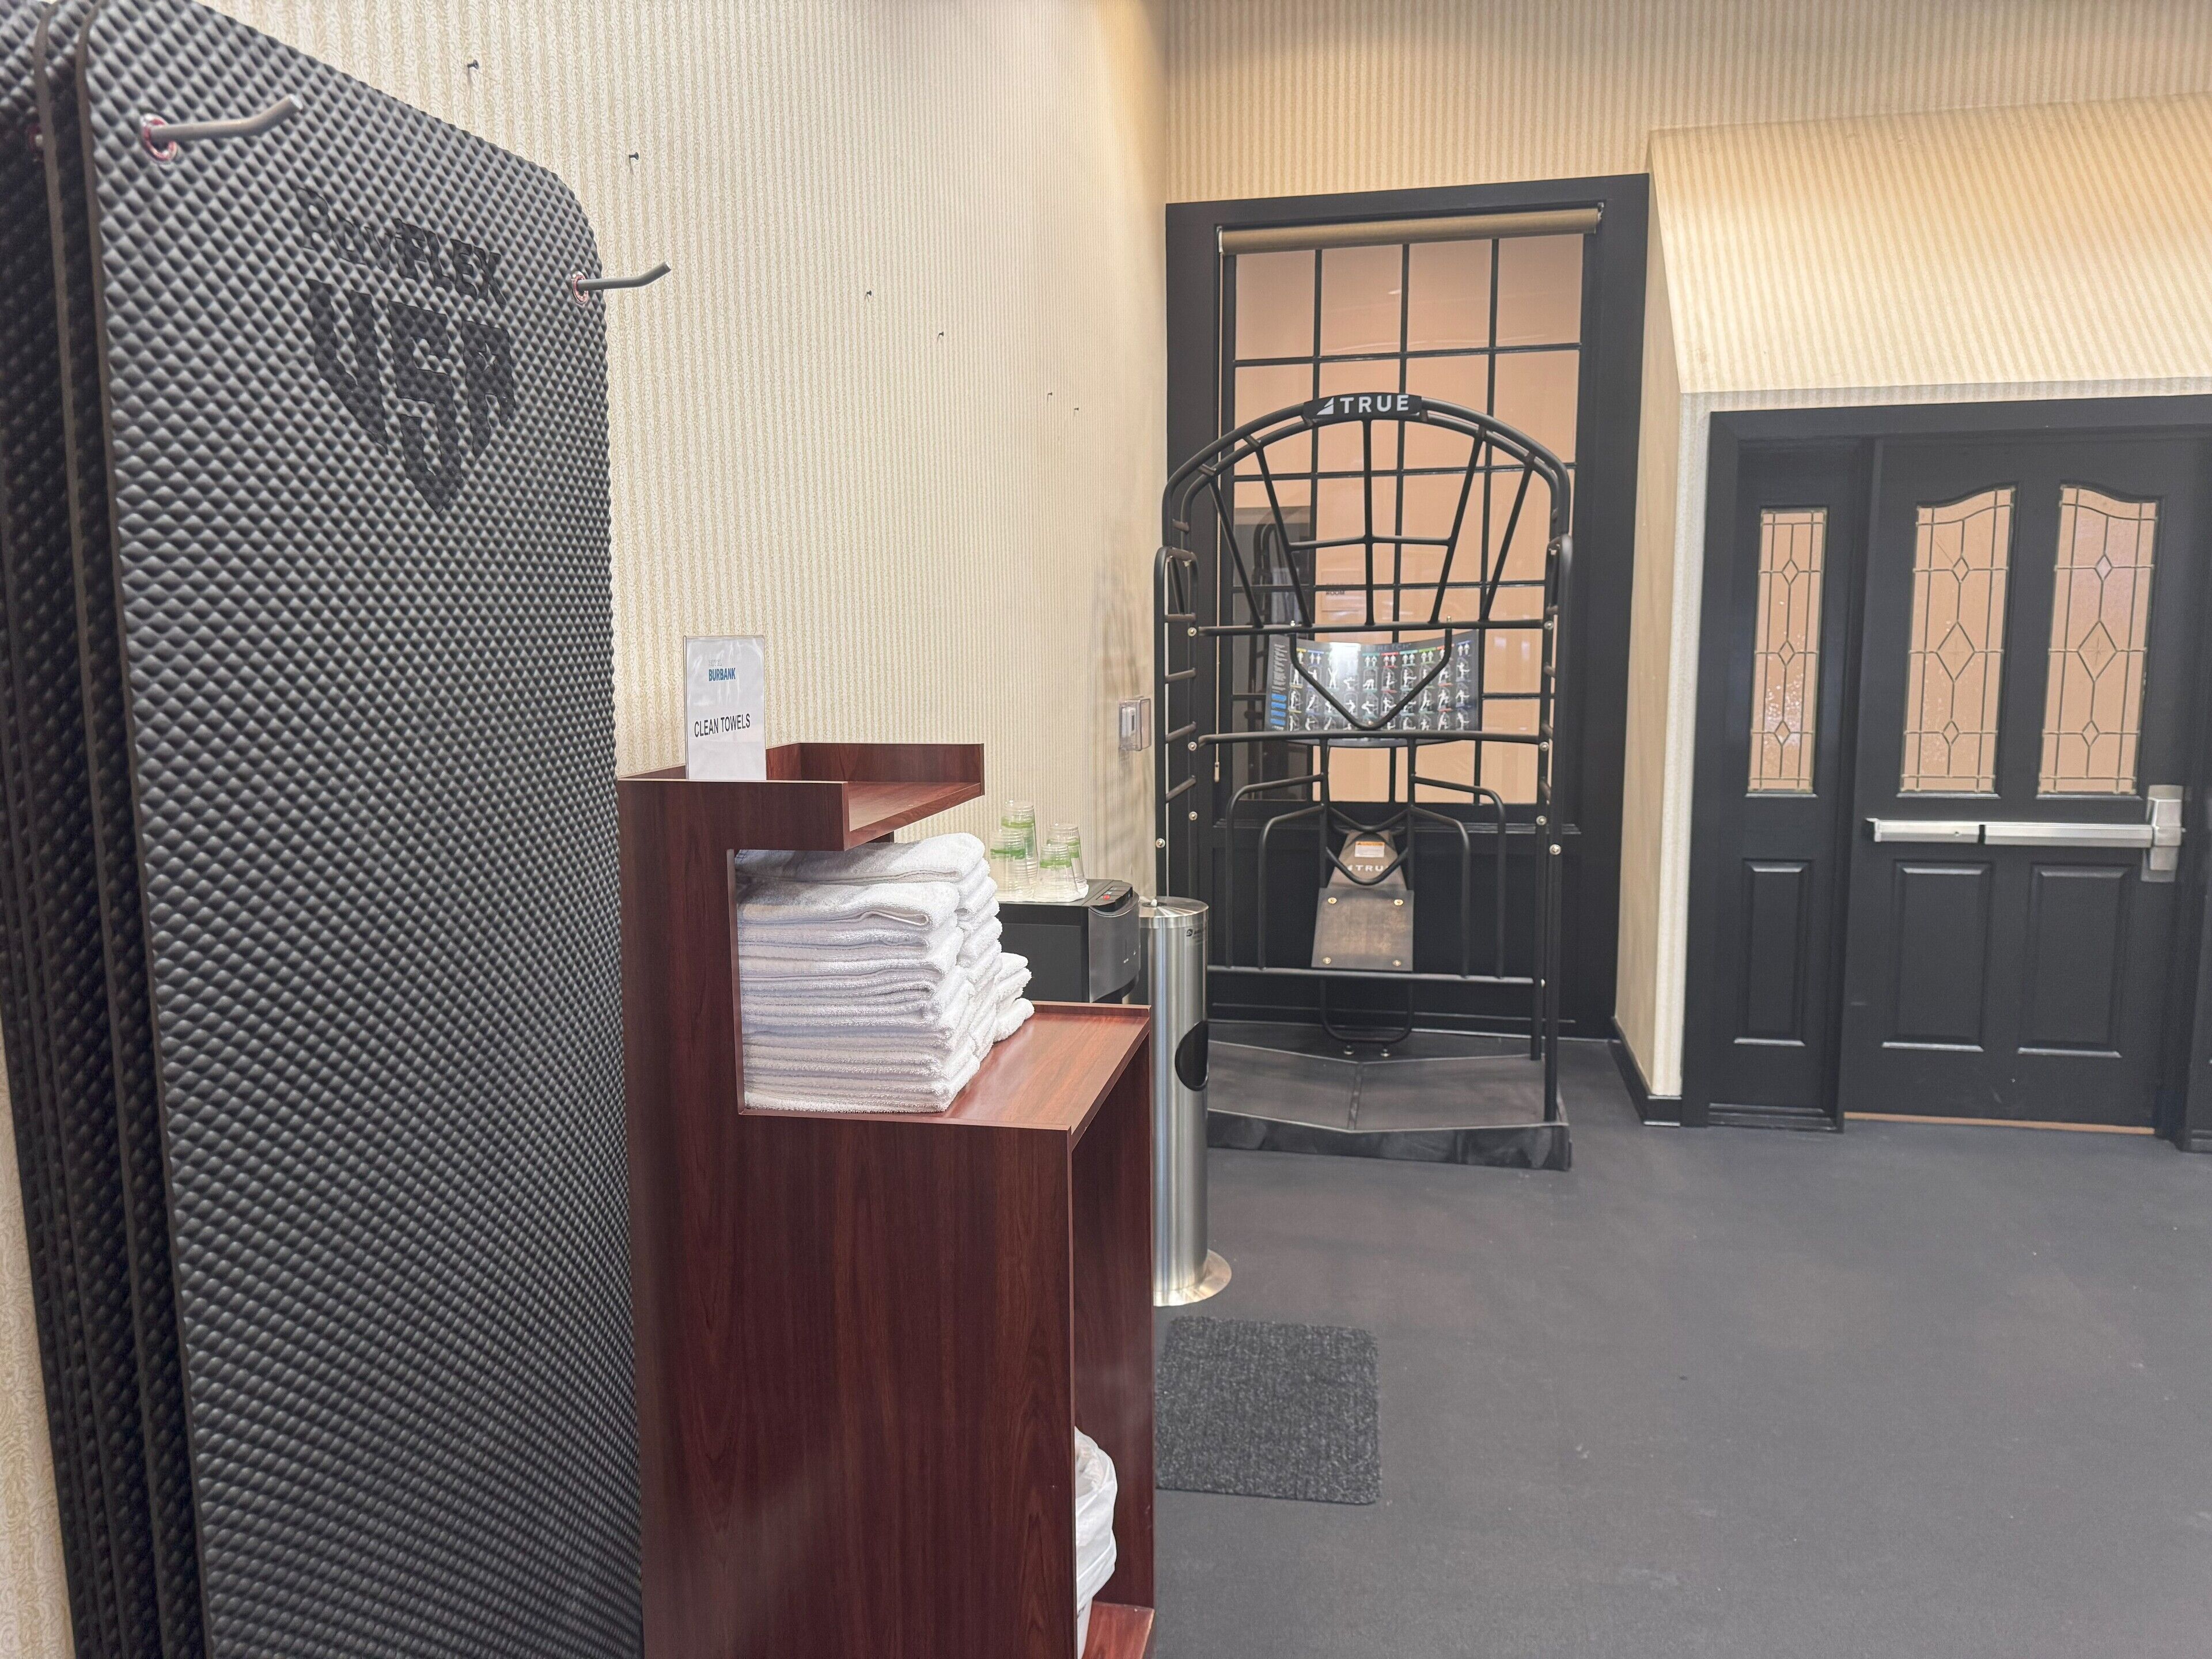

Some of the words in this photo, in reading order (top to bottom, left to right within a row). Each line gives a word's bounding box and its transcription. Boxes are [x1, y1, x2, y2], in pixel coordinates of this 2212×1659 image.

[1340, 395, 1409, 414] TRUE
[709, 668, 736, 681] BURBANK
[694, 718, 718, 737] CLEAN
[721, 713, 751, 732] TOWELS
